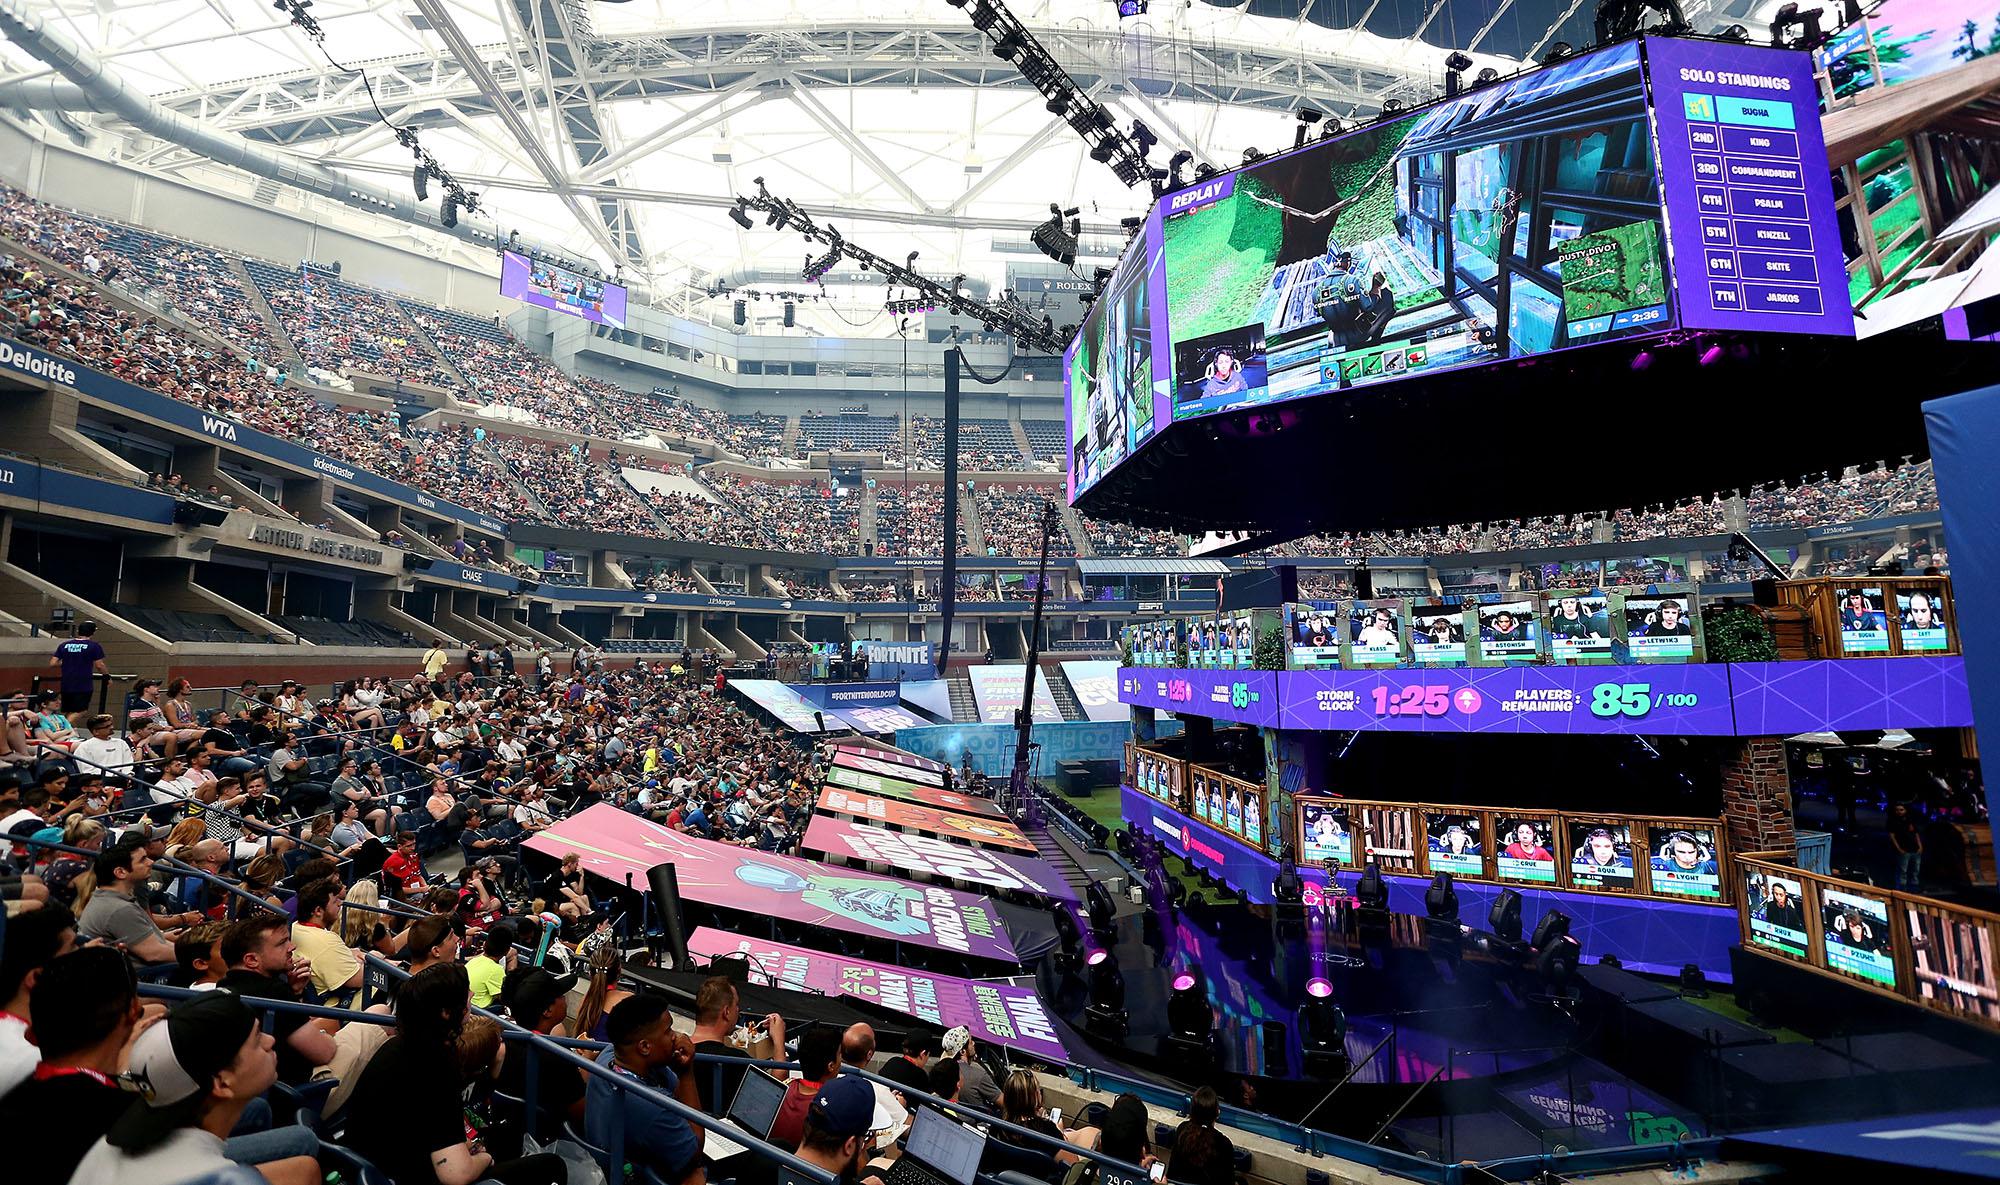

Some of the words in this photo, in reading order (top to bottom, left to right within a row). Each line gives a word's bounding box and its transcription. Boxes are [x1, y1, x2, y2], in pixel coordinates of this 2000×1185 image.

[1680, 68, 1715, 84] SOLO
[1717, 71, 1791, 91] STANDINGS
[1688, 97, 1710, 118] #1
[1742, 107, 1769, 118] BUGHA
[1693, 132, 1714, 145] 2ND
[1750, 136, 1770, 148] KING
[1697, 162, 1719, 175] 3RD
[1731, 165, 1796, 180] COMMANDMENT
[1171, 181, 1224, 209] REPLAY
[1702, 194, 1723, 207] 4TH
[1754, 198, 1783, 209] PSALM
[1706, 226, 1727, 238] 5TH
[1757, 229, 1791, 241] KINZELL
[1558, 249, 1587, 262] DUSTY
[1589, 242, 1617, 256] DIVOT
[1710, 258, 1732, 270] 6TH
[1766, 261, 1791, 272] SKITE
[1056, 281, 1092, 290] ROLEX
[1314, 299, 1339, 309] CONFIRM
[1344, 294, 1361, 302] RESET
[1715, 290, 1736, 302] 7TH
[1766, 292, 1800, 304] JARKOS
[1632, 310, 1659, 322] 2:36
[0, 342, 76, 385] Deloitte
[202, 414, 237, 442] WTA
[313, 457, 355, 481] ticketmaster
[417, 494, 435, 509] WESTIN
[254, 525, 305, 550] ARTHUR
[308, 536, 338, 556] ASHE
[462, 569, 482, 583] CHASE
[918, 604, 937, 612] IBM
[1138, 602, 1163, 610] ESPN
[867, 645, 928, 665] FORTNITE
[831, 690, 897, 701] #FORTNITEWORLDCUP
[1168, 680, 1185, 702] 1:25
[1232, 682, 1248, 708] 85
[1316, 691, 1354, 701] STORM
[1515, 690, 1573, 701] PLAYERS
[1591, 683, 1651, 717] 85
[1319, 700, 1354, 711] CLOCK
[1372, 685, 1449, 717] 1:25
[1502, 700, 1573, 712] REMAINING
[898, 834, 1024, 889] CUP
[926, 887, 957, 907] CUP
[929, 906, 971, 952] WORLD
[960, 905, 996, 939] FINALS
[379, 973, 385, 985] H
[780, 955, 809, 993] ИНАЛЫ
[879, 971, 911, 1013] INAŁY
[1005, 995, 1060, 1043] FINAL
[1107, 1174, 1120, 1185] 29
